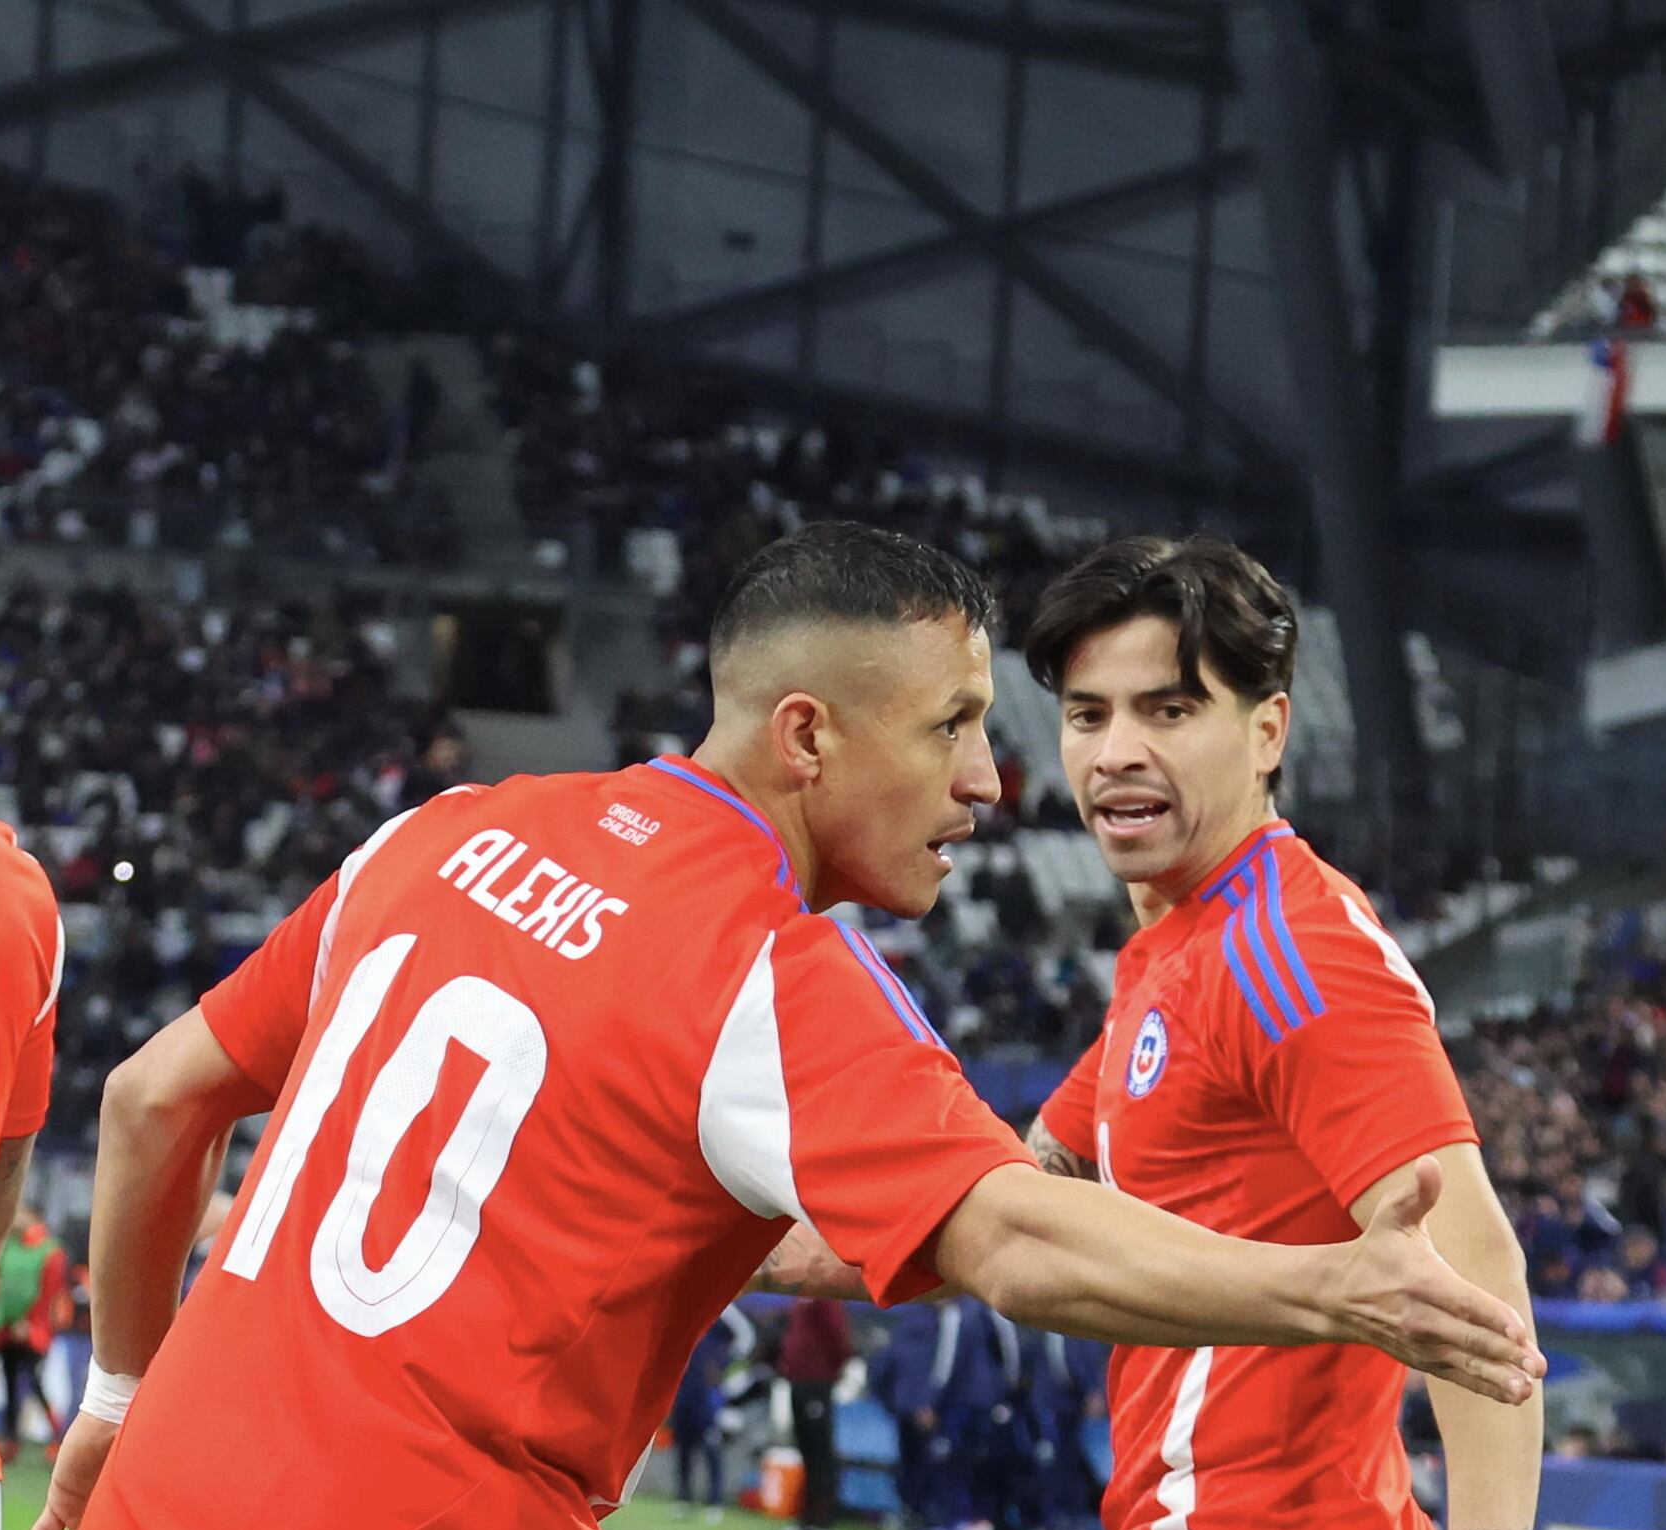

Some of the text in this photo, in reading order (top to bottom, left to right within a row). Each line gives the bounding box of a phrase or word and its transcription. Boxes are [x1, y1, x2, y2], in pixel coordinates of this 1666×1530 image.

[597, 816, 649, 847] CHILENO
[606, 802, 661, 835] ORGULLO
[437, 828, 630, 960] ALEXIS
[221, 932, 548, 1338] 10
